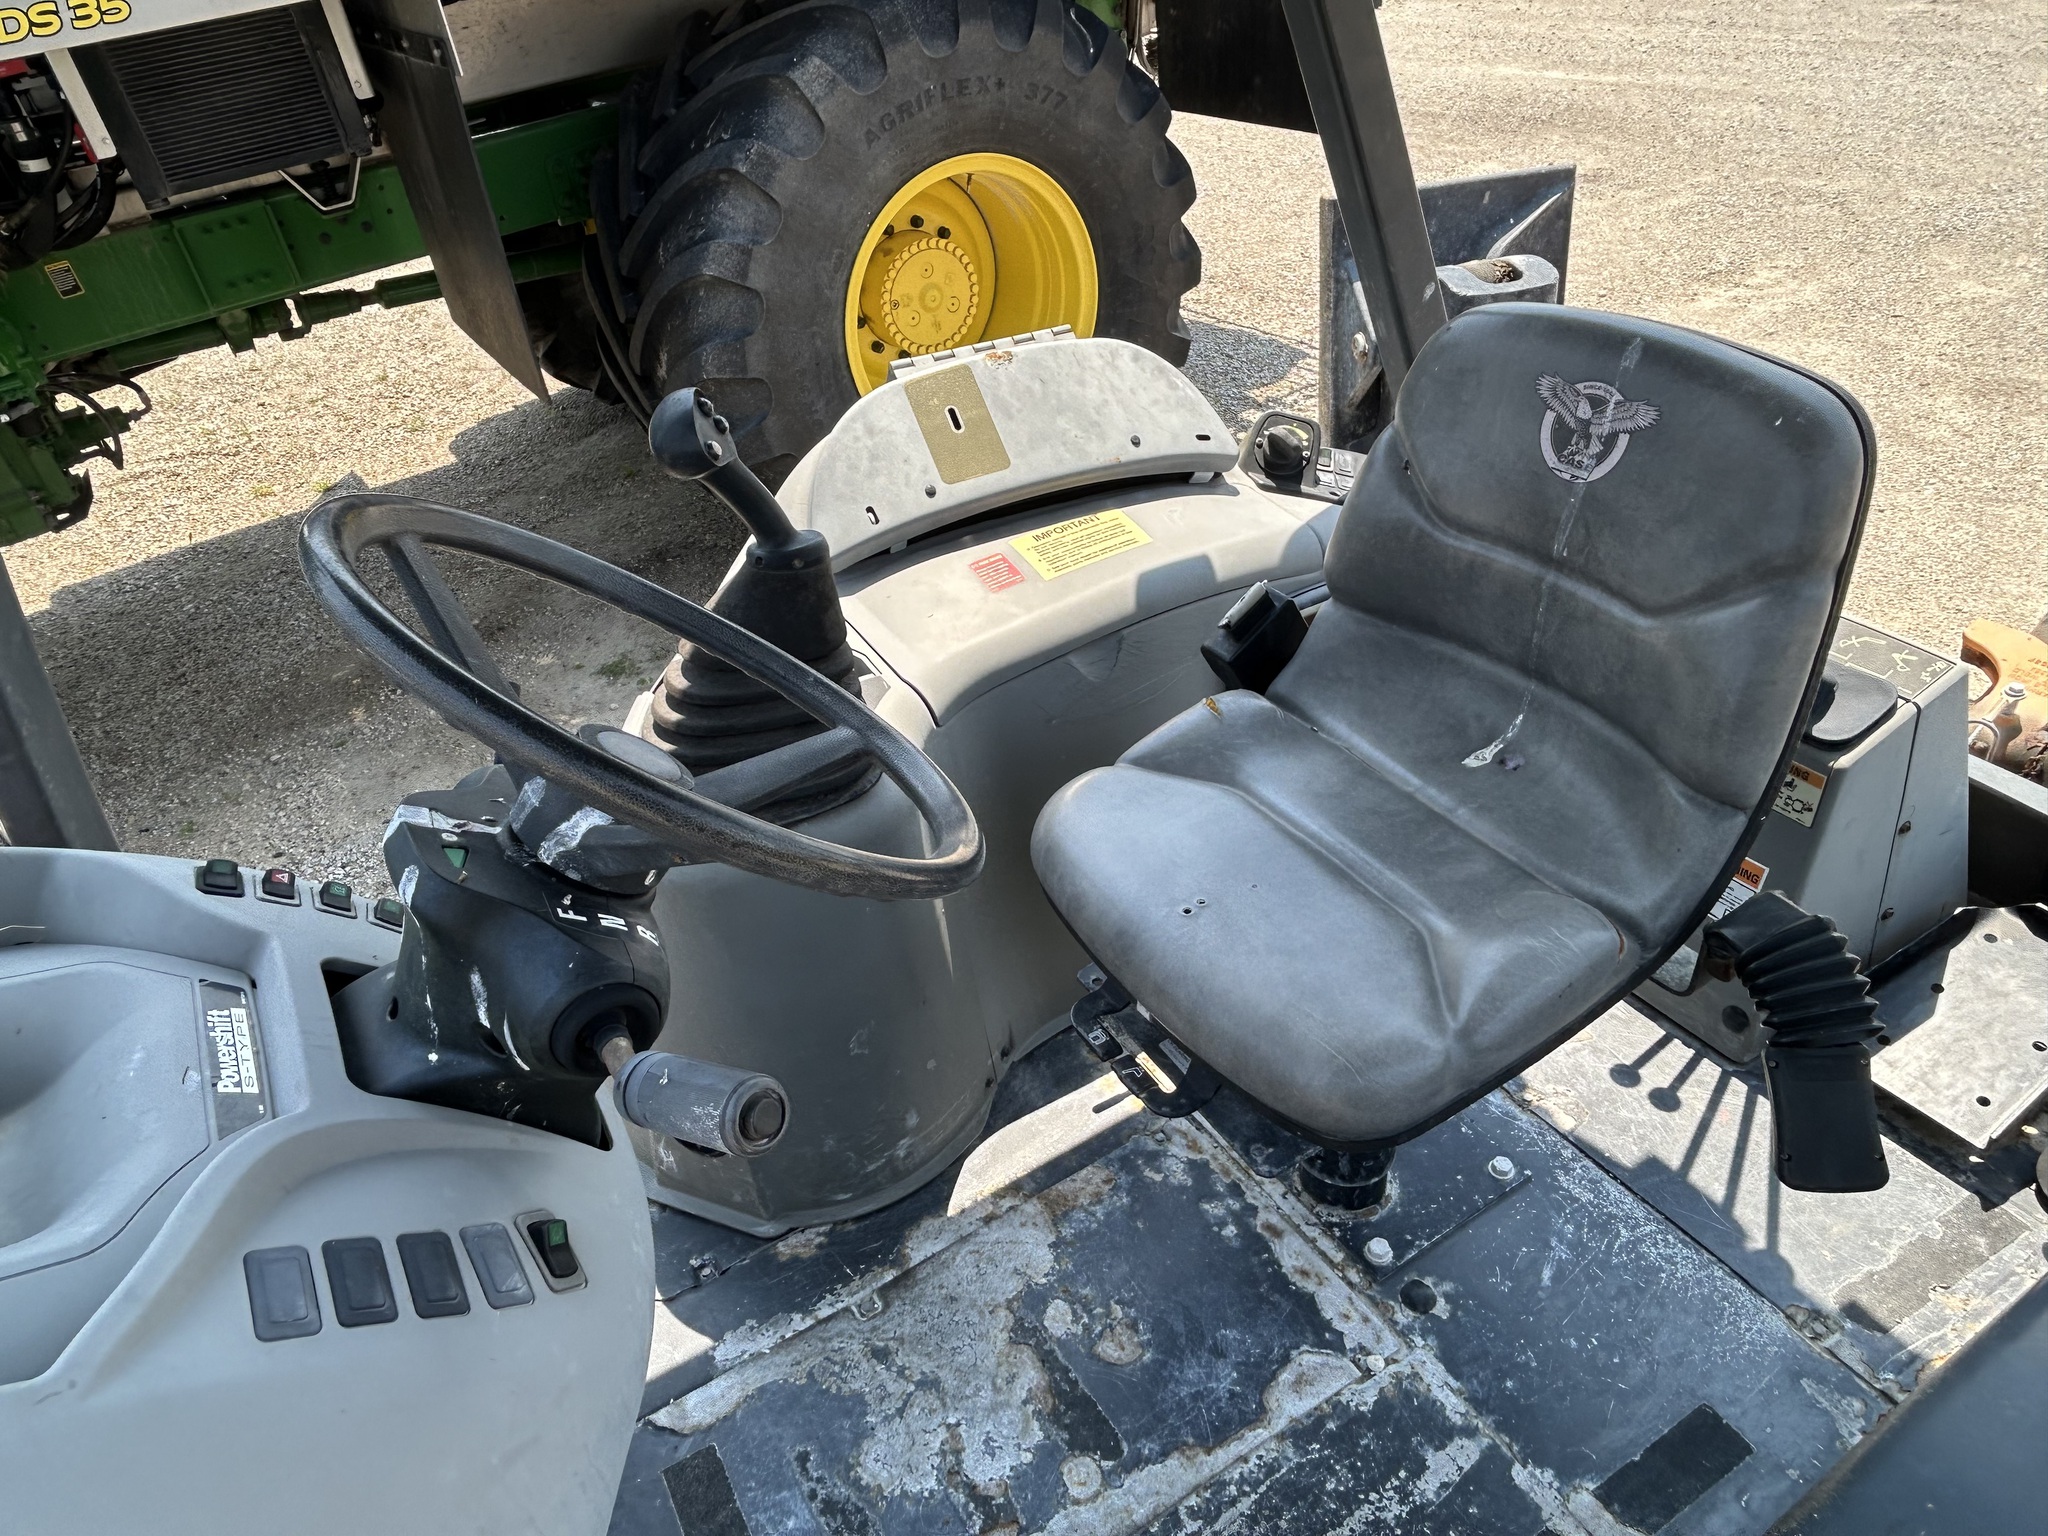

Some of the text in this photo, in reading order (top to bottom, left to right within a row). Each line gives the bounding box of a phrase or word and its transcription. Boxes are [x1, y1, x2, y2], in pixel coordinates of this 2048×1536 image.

[1024, 82, 1068, 112] 377
[1032, 515, 1101, 543] IMPORTANT
[206, 1009, 242, 1093] Powershift
[233, 1012, 255, 1088] S-TYPE
